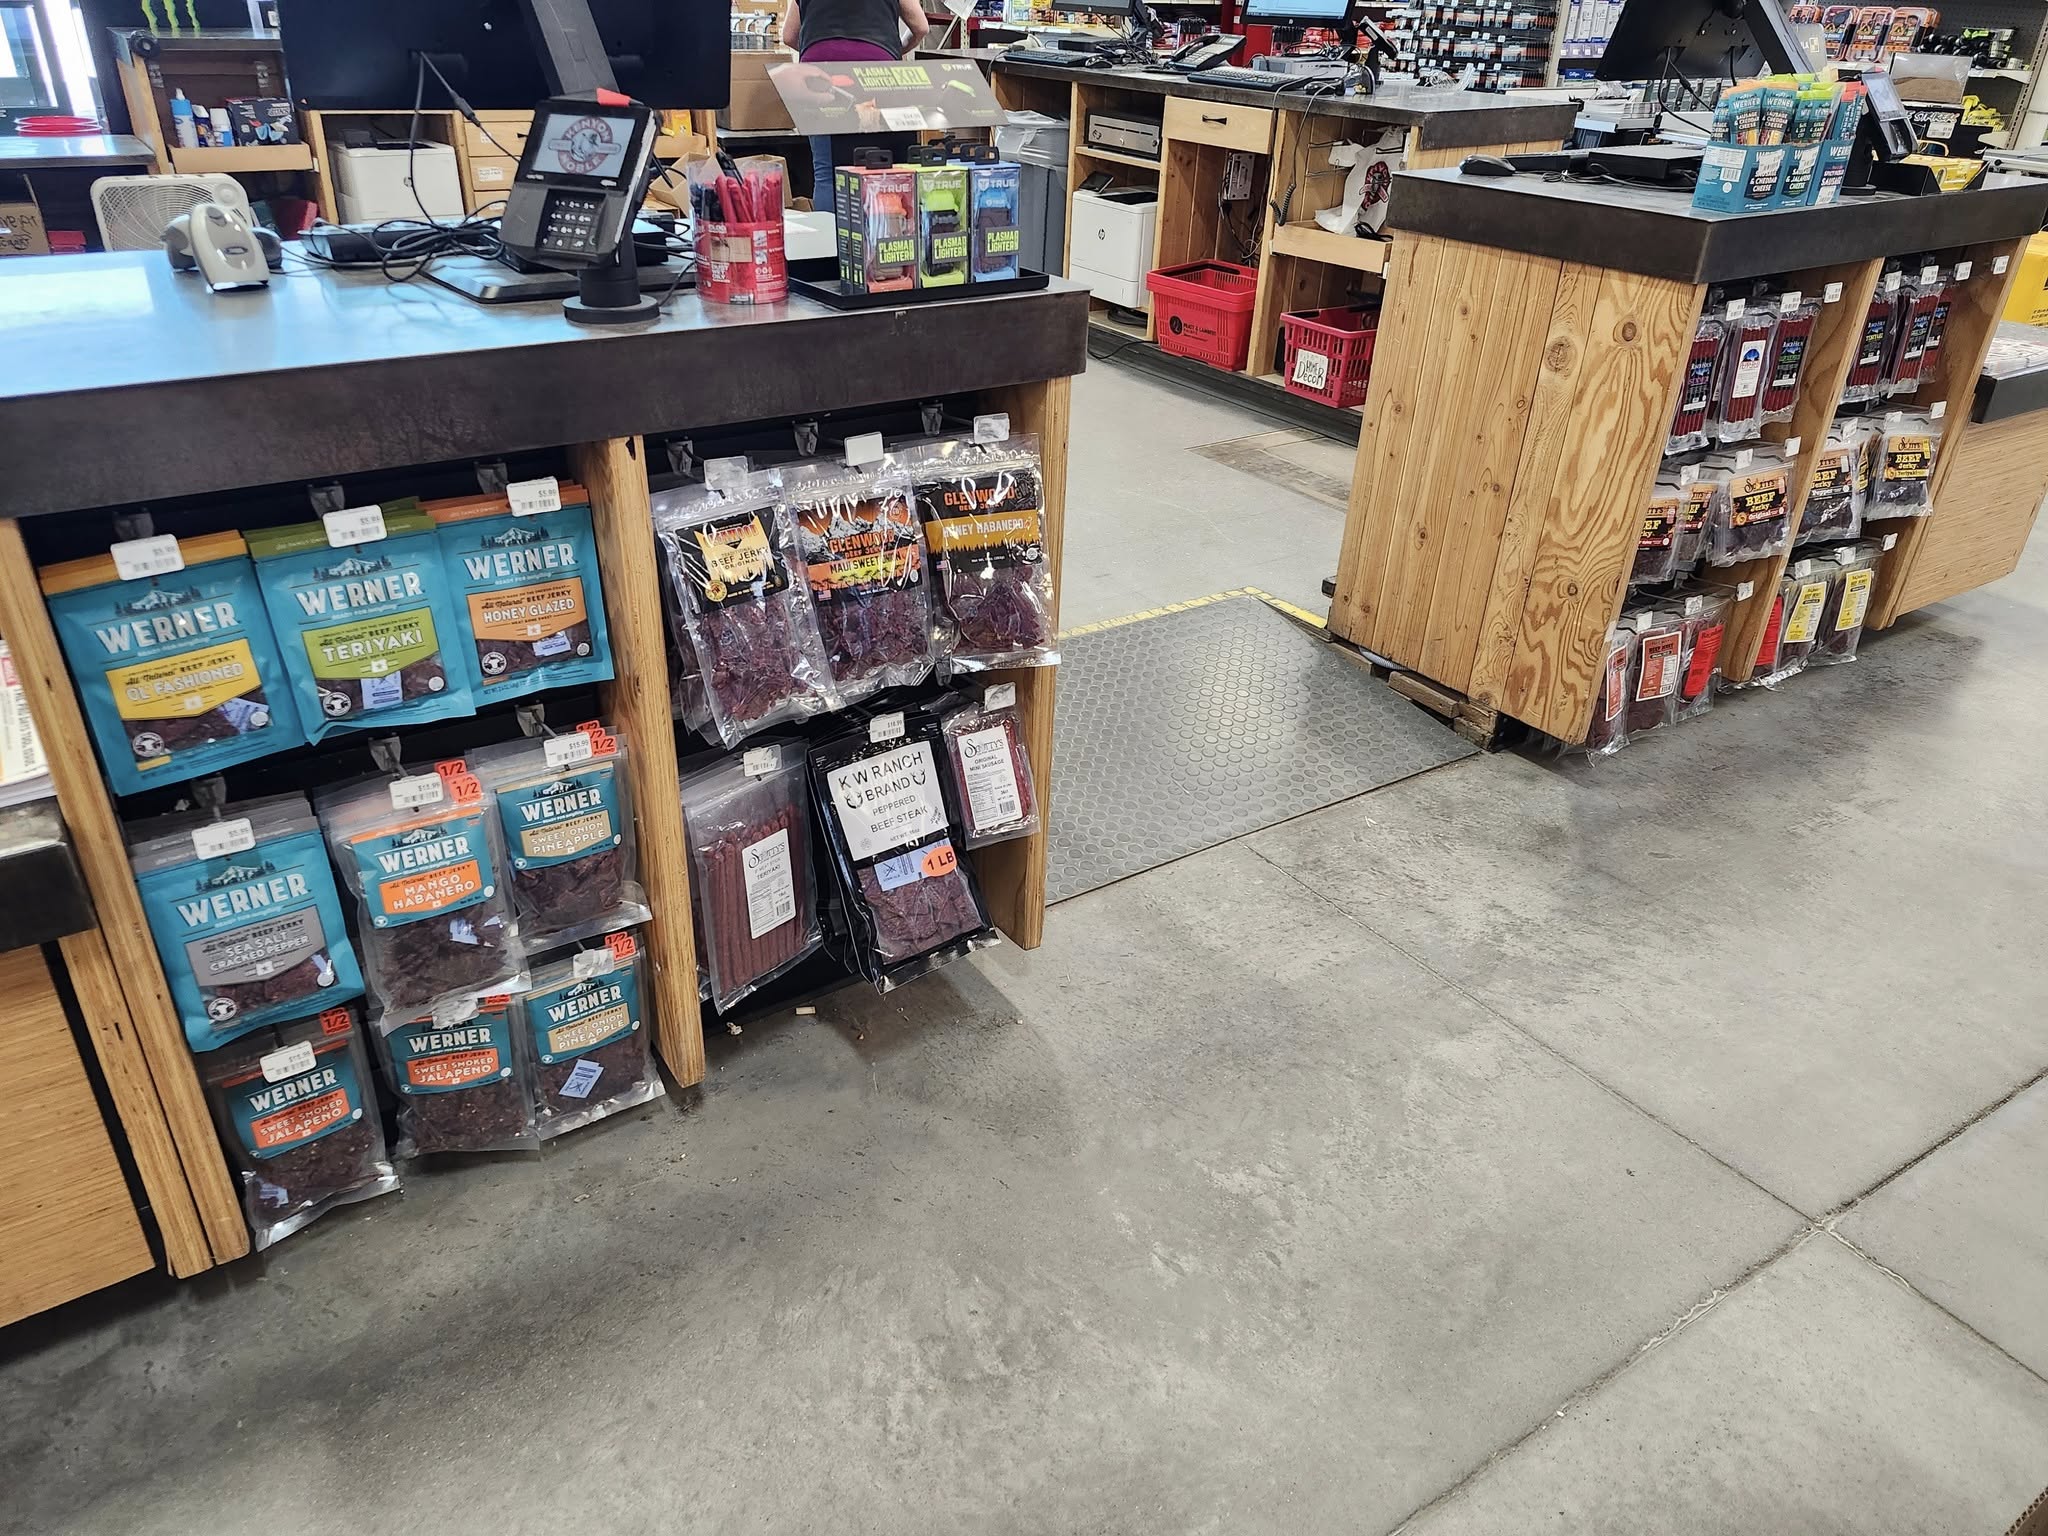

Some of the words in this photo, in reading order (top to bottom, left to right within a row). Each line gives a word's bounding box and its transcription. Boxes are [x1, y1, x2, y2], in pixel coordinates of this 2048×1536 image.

[853, 67, 893, 77] PLASMA
[893, 68, 928, 85] XRL
[859, 77, 898, 87] LIGHTER
[1732, 97, 1761, 109] WERNER
[1736, 111, 1758, 120] SAUSAGE
[1738, 117, 1761, 126] CHEDDAR
[1766, 111, 1788, 119] SAUSAGE
[1766, 116, 1788, 124] CHEDDAR
[1738, 121, 1757, 130] CHEESE
[1765, 121, 1783, 129] CHEESE
[882, 183, 911, 192] TRUE
[935, 180, 961, 189] TRUE
[989, 178, 1017, 187] TRUE
[1755, 176, 1778, 184] CHEDDAR
[1789, 182, 1806, 190] CHEESE
[1821, 177, 1843, 187] SAUSAGE
[1752, 184, 1772, 193] CHEESE
[934, 236, 962, 248] PLASMA
[987, 231, 1014, 243] PLASMA
[878, 239, 910, 252] PLASMA
[987, 241, 1014, 252] LIGHTER
[879, 251, 911, 264] LIGHTER
[934, 247, 963, 260] LIGHTER
[1894, 453, 1922, 464] BEEF
[1898, 462, 1918, 470] Jerky
[1814, 469, 1838, 482] EEF
[1745, 491, 1776, 507] BEEF
[1751, 502, 1770, 512] Jerky
[1748, 511, 1772, 520] Original
[943, 523, 974, 538] HONEY
[977, 518, 1024, 534] HABANERO
[1643, 520, 1661, 530] EF
[463, 543, 576, 580] WERNER
[711, 556, 738, 568] BEEF
[725, 557, 760, 570] ORIGINAL
[830, 562, 851, 574] MAUI
[853, 555, 880, 569] SWEET
[295, 572, 424, 617] WERNER
[527, 594, 545, 603] BEEF
[547, 590, 572, 600] JERKY
[483, 607, 527, 624] HONEY
[529, 598, 576, 616] GLAZED
[95, 601, 241, 655] WERNER
[368, 627, 390, 637] BEEF
[393, 621, 420, 633] JERKY
[322, 629, 423, 663] TERIYAKI
[154, 662, 245, 694] FASHIONED
[593, 738, 615, 751] 1/2
[970, 764, 982, 772] MINI
[981, 758, 1005, 770] SAUSAGE
[974, 754, 998, 765] ORIGINAL
[440, 761, 465, 777] 1/2
[839, 776, 852, 791] K
[852, 771, 868, 785] W
[872, 751, 924, 780] RANCH
[456, 781, 480, 796] 1/2
[866, 777, 911, 802] BRAND
[521, 788, 602, 822] WERNER
[872, 795, 917, 817] PEPPERED
[565, 818, 580, 828] BEEF
[582, 814, 602, 824] JERKY
[870, 819, 895, 833] BEEF
[897, 806, 928, 825] STEAK
[531, 830, 567, 845] SWEET
[569, 821, 605, 836] ONION
[533, 829, 606, 855] PINEAPPLE
[378, 836, 471, 875] WERNER
[927, 860, 936, 871] 1
[939, 851, 955, 867] LB
[756, 864, 781, 881] TERIYAKI
[404, 874, 461, 897] MANGO
[176, 873, 309, 928] WERNER
[393, 880, 475, 911] HABANERO
[252, 928, 274, 939] BEEF
[276, 919, 305, 932] JERKY
[224, 941, 256, 958] SEA
[255, 931, 289, 951] SALT
[614, 939, 632, 953] 1/2
[209, 950, 265, 972] CRACKED
[266, 934, 310, 956] PEPPER
[548, 985, 622, 1023] WERNER
[325, 1012, 348, 1029] 1/2
[588, 1015, 603, 1023] BEEF
[604, 1007, 623, 1020] JERKY
[556, 1027, 584, 1042] SWEET
[585, 1012, 623, 1034] ONION
[558, 1019, 625, 1050] PINEAPPLE
[408, 1028, 493, 1054] WERNER
[451, 1053, 469, 1061] BEEF
[470, 1050, 491, 1059] JERKY
[414, 1062, 450, 1075] SWEET
[451, 1055, 494, 1070] SMOKED
[249, 1068, 337, 1112] WERNER
[260, 1116, 296, 1136] SWEET
[297, 1098, 344, 1121] SMOKED
